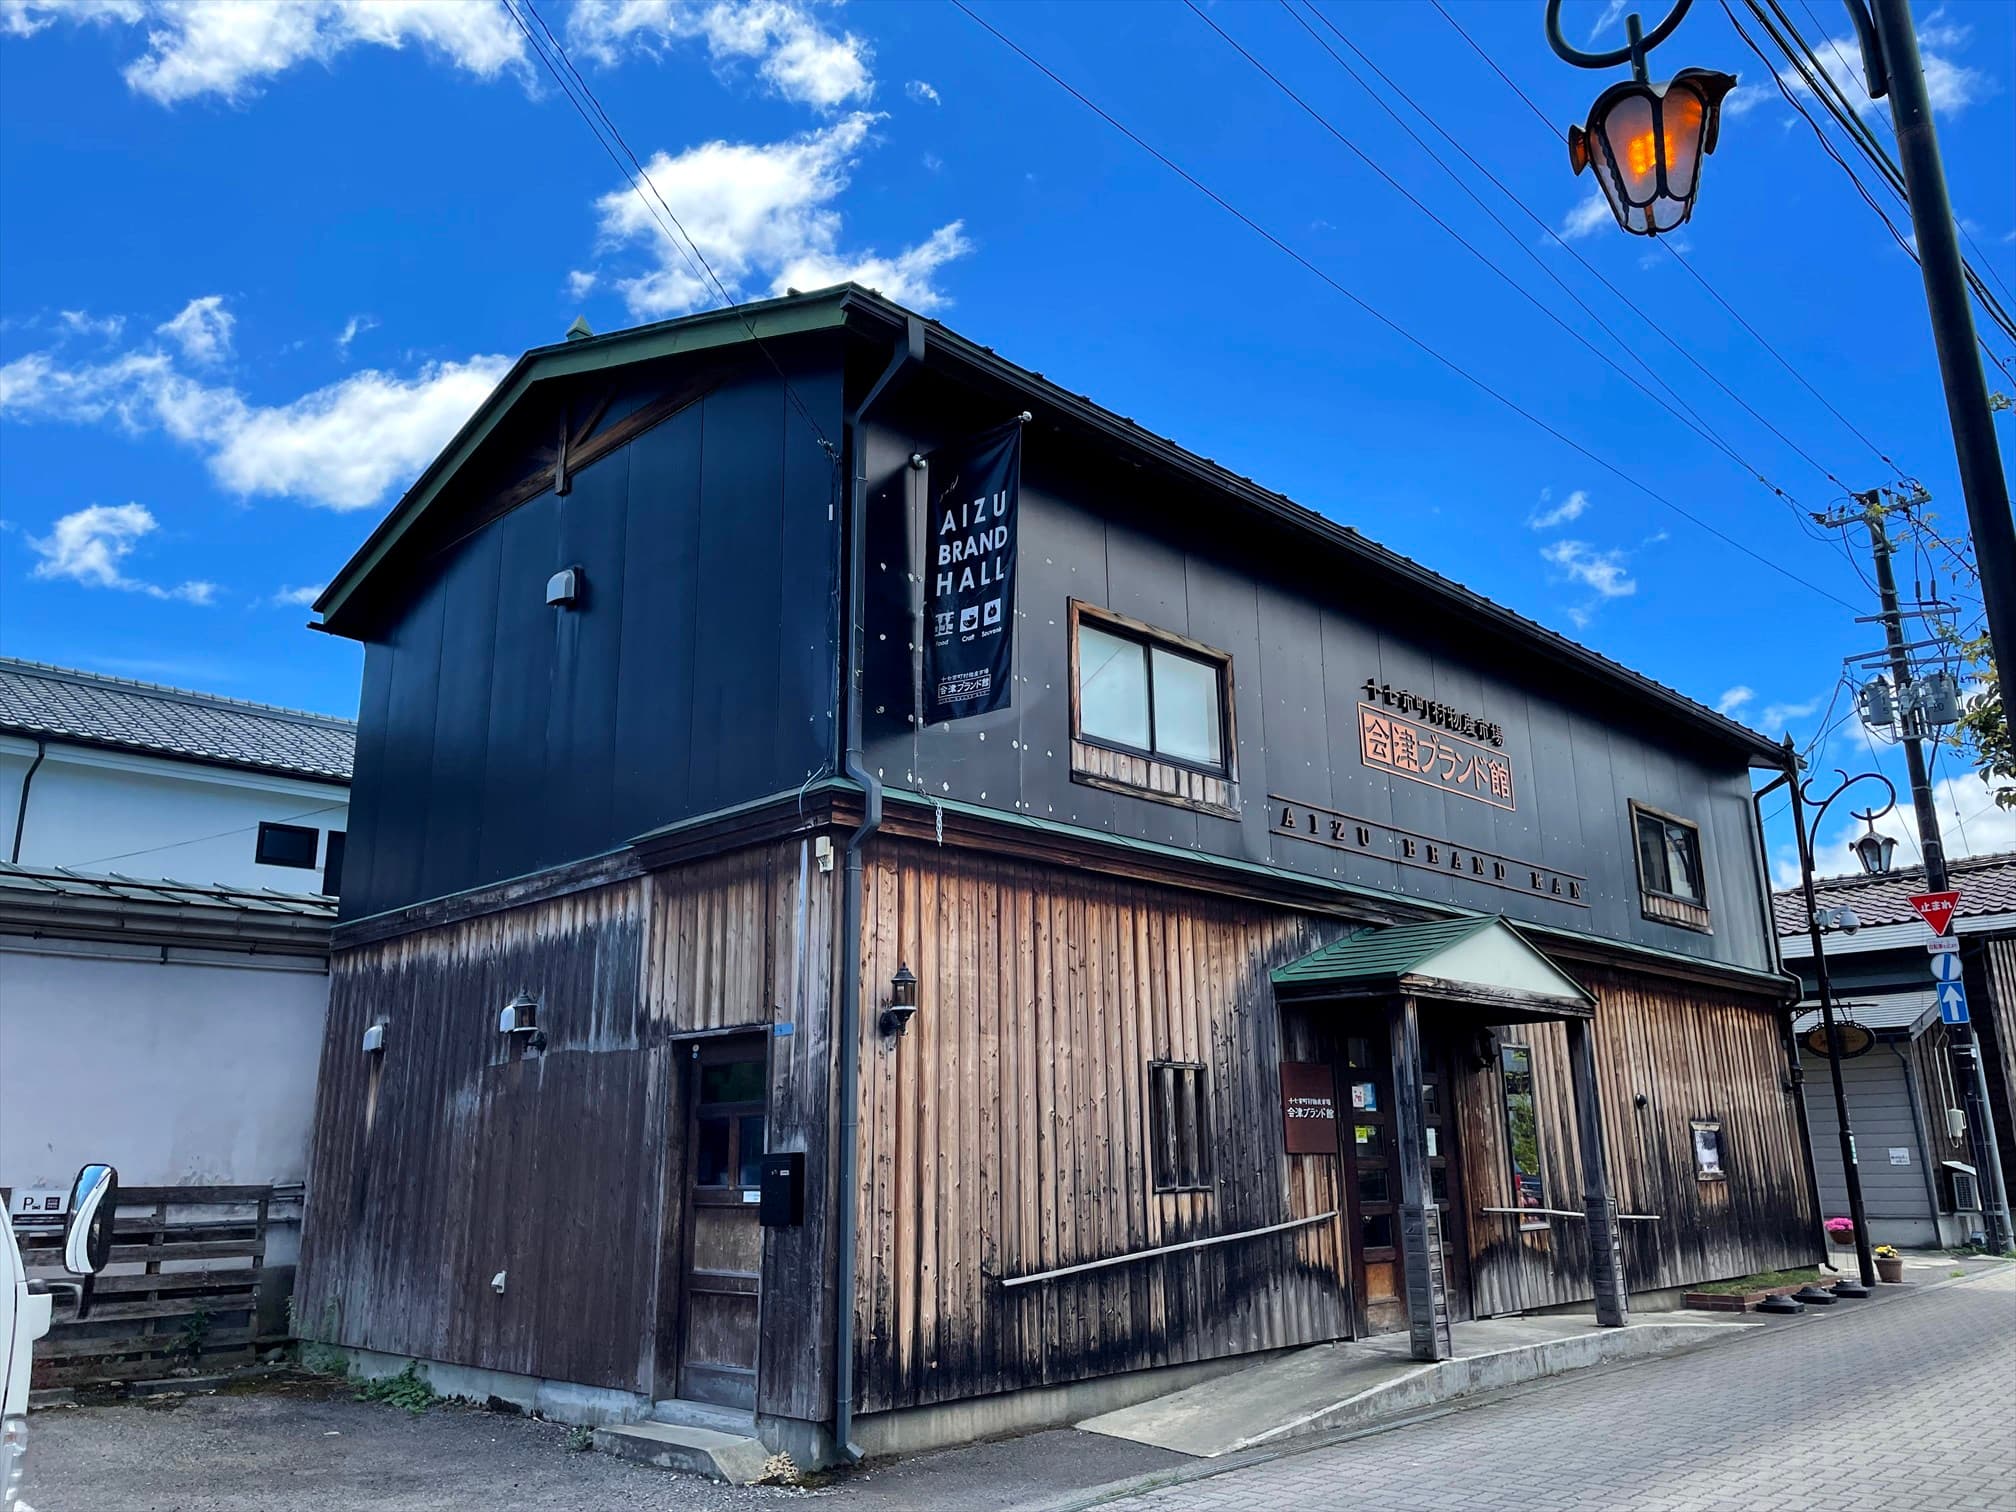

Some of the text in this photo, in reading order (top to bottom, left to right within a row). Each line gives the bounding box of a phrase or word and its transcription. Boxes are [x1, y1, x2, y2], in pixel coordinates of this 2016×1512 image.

[940, 490, 1006, 535] AIZU
[938, 526, 1008, 565] BRAND
[936, 556, 1004, 596] HALL
[1361, 677, 1505, 747] 十七市町村物産市場
[1364, 713, 1510, 799] 会津ブランド館
[1281, 806, 1582, 899] AIZU BRAND KAN
[1920, 899, 1953, 913] 止まれ
